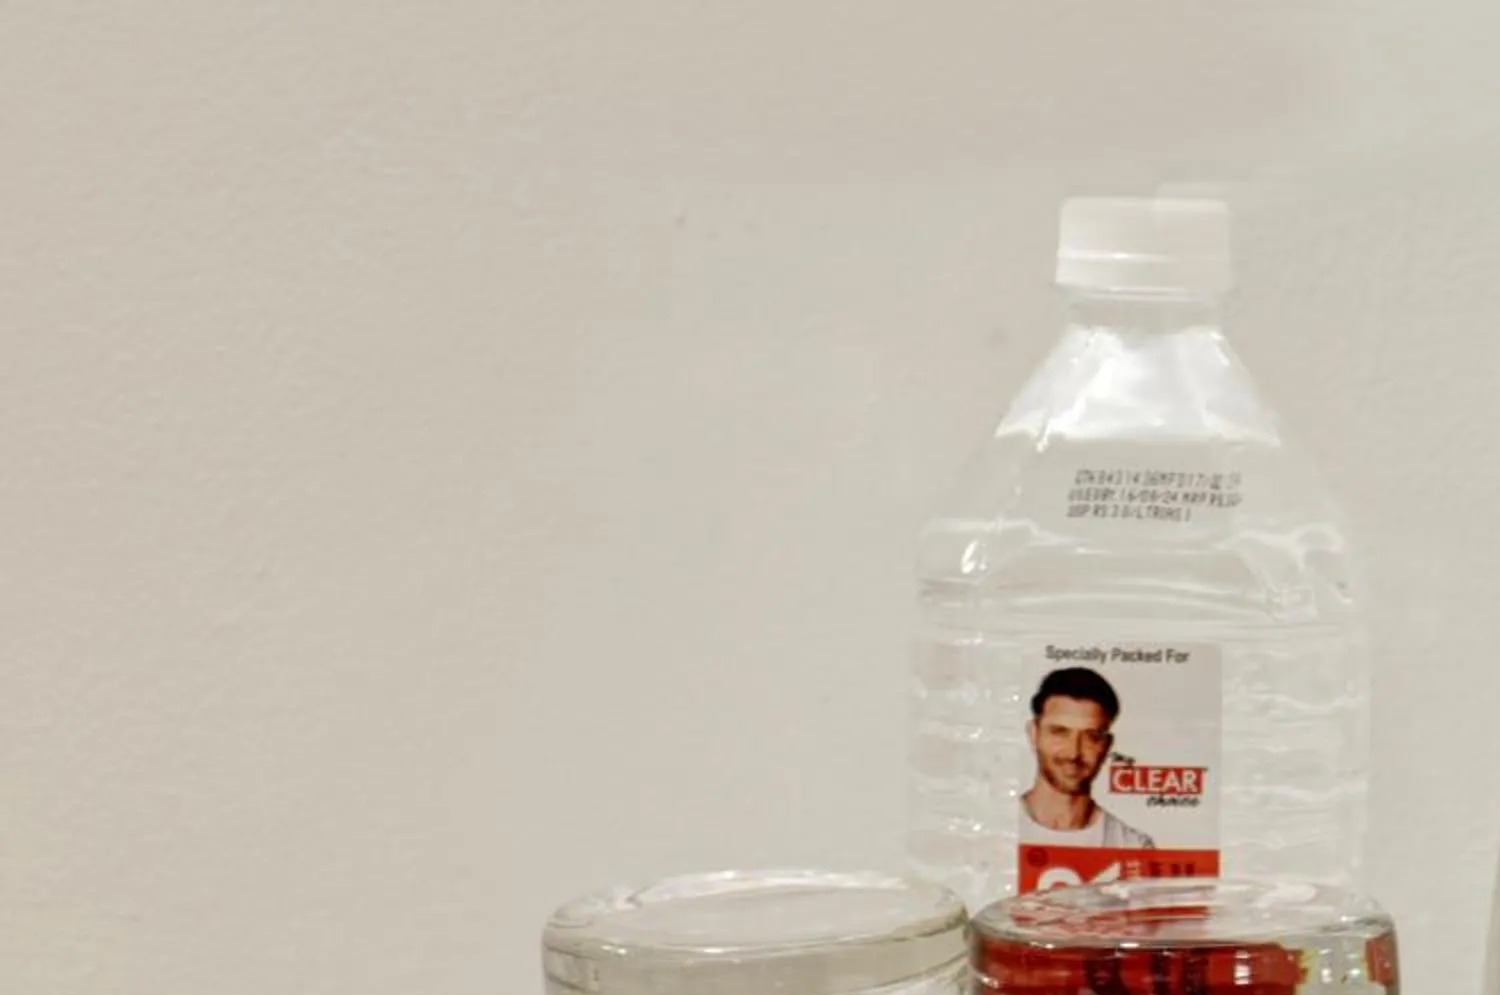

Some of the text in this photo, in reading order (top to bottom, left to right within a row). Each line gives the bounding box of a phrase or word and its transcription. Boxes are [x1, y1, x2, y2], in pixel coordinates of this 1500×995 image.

[1045, 645, 1190, 664] Specially Packed For
[1112, 768, 1199, 793] CLEAR
